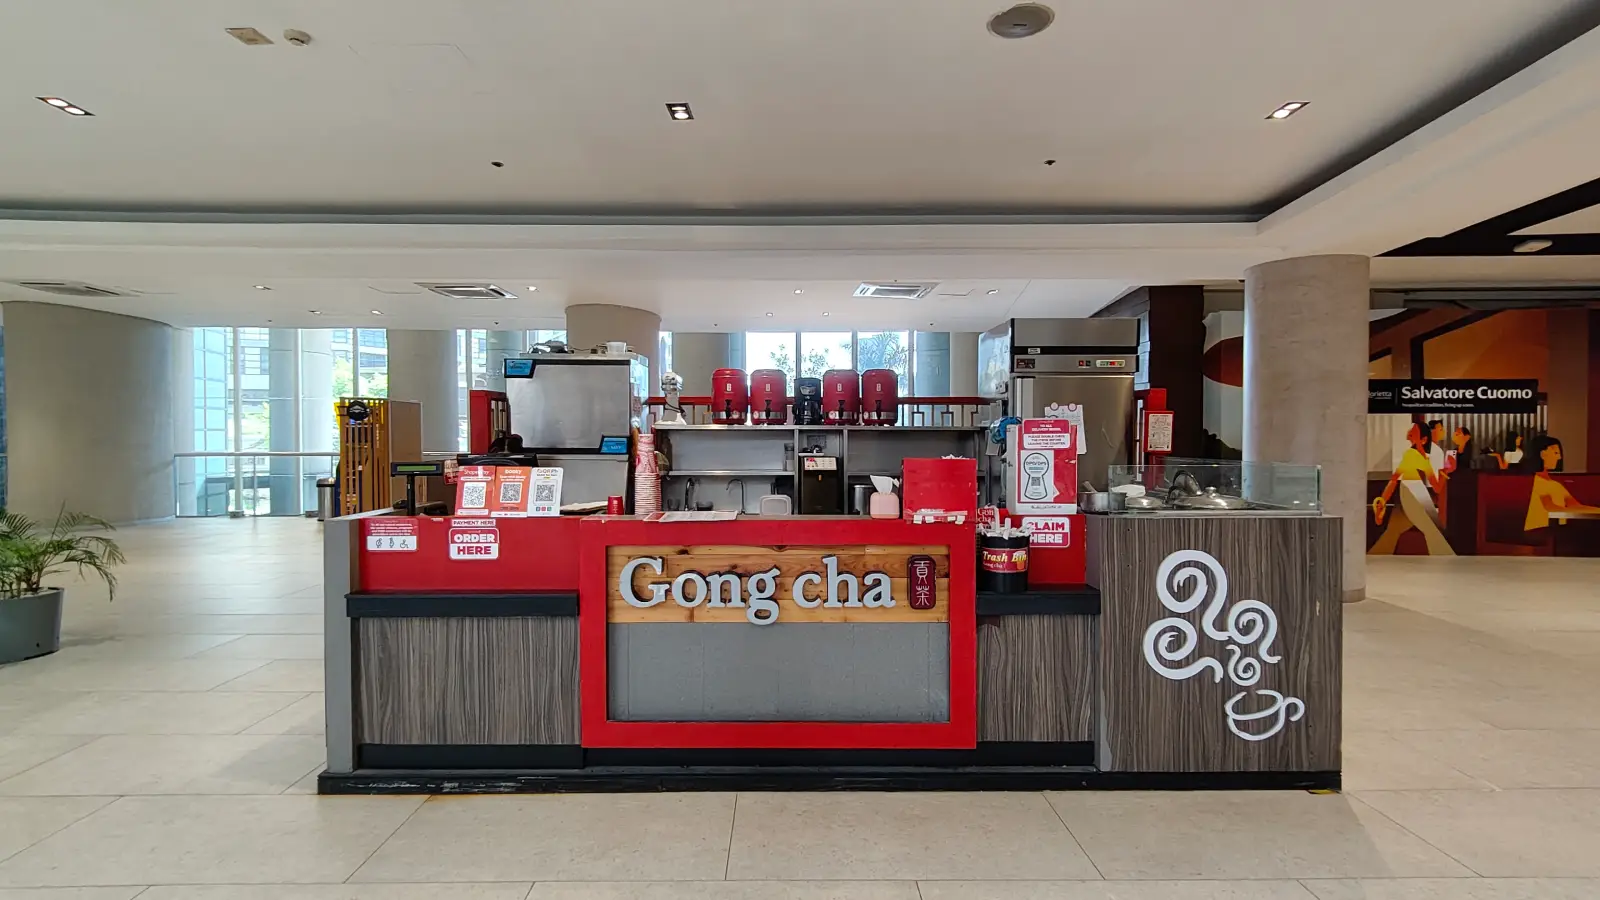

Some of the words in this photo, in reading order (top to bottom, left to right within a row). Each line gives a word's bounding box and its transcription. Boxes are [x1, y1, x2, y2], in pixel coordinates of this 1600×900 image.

[1401, 386, 1475, 399] Salvatore
[1476, 386, 1533, 399] Cuomo
[454, 533, 495, 543] ORDER
[1030, 533, 1063, 544] HERE
[457, 546, 491, 555] HERE
[983, 551, 1008, 562] Trash
[1011, 552, 1027, 562] Bin
[619, 556, 780, 625] Gong
[792, 555, 896, 609] cha
